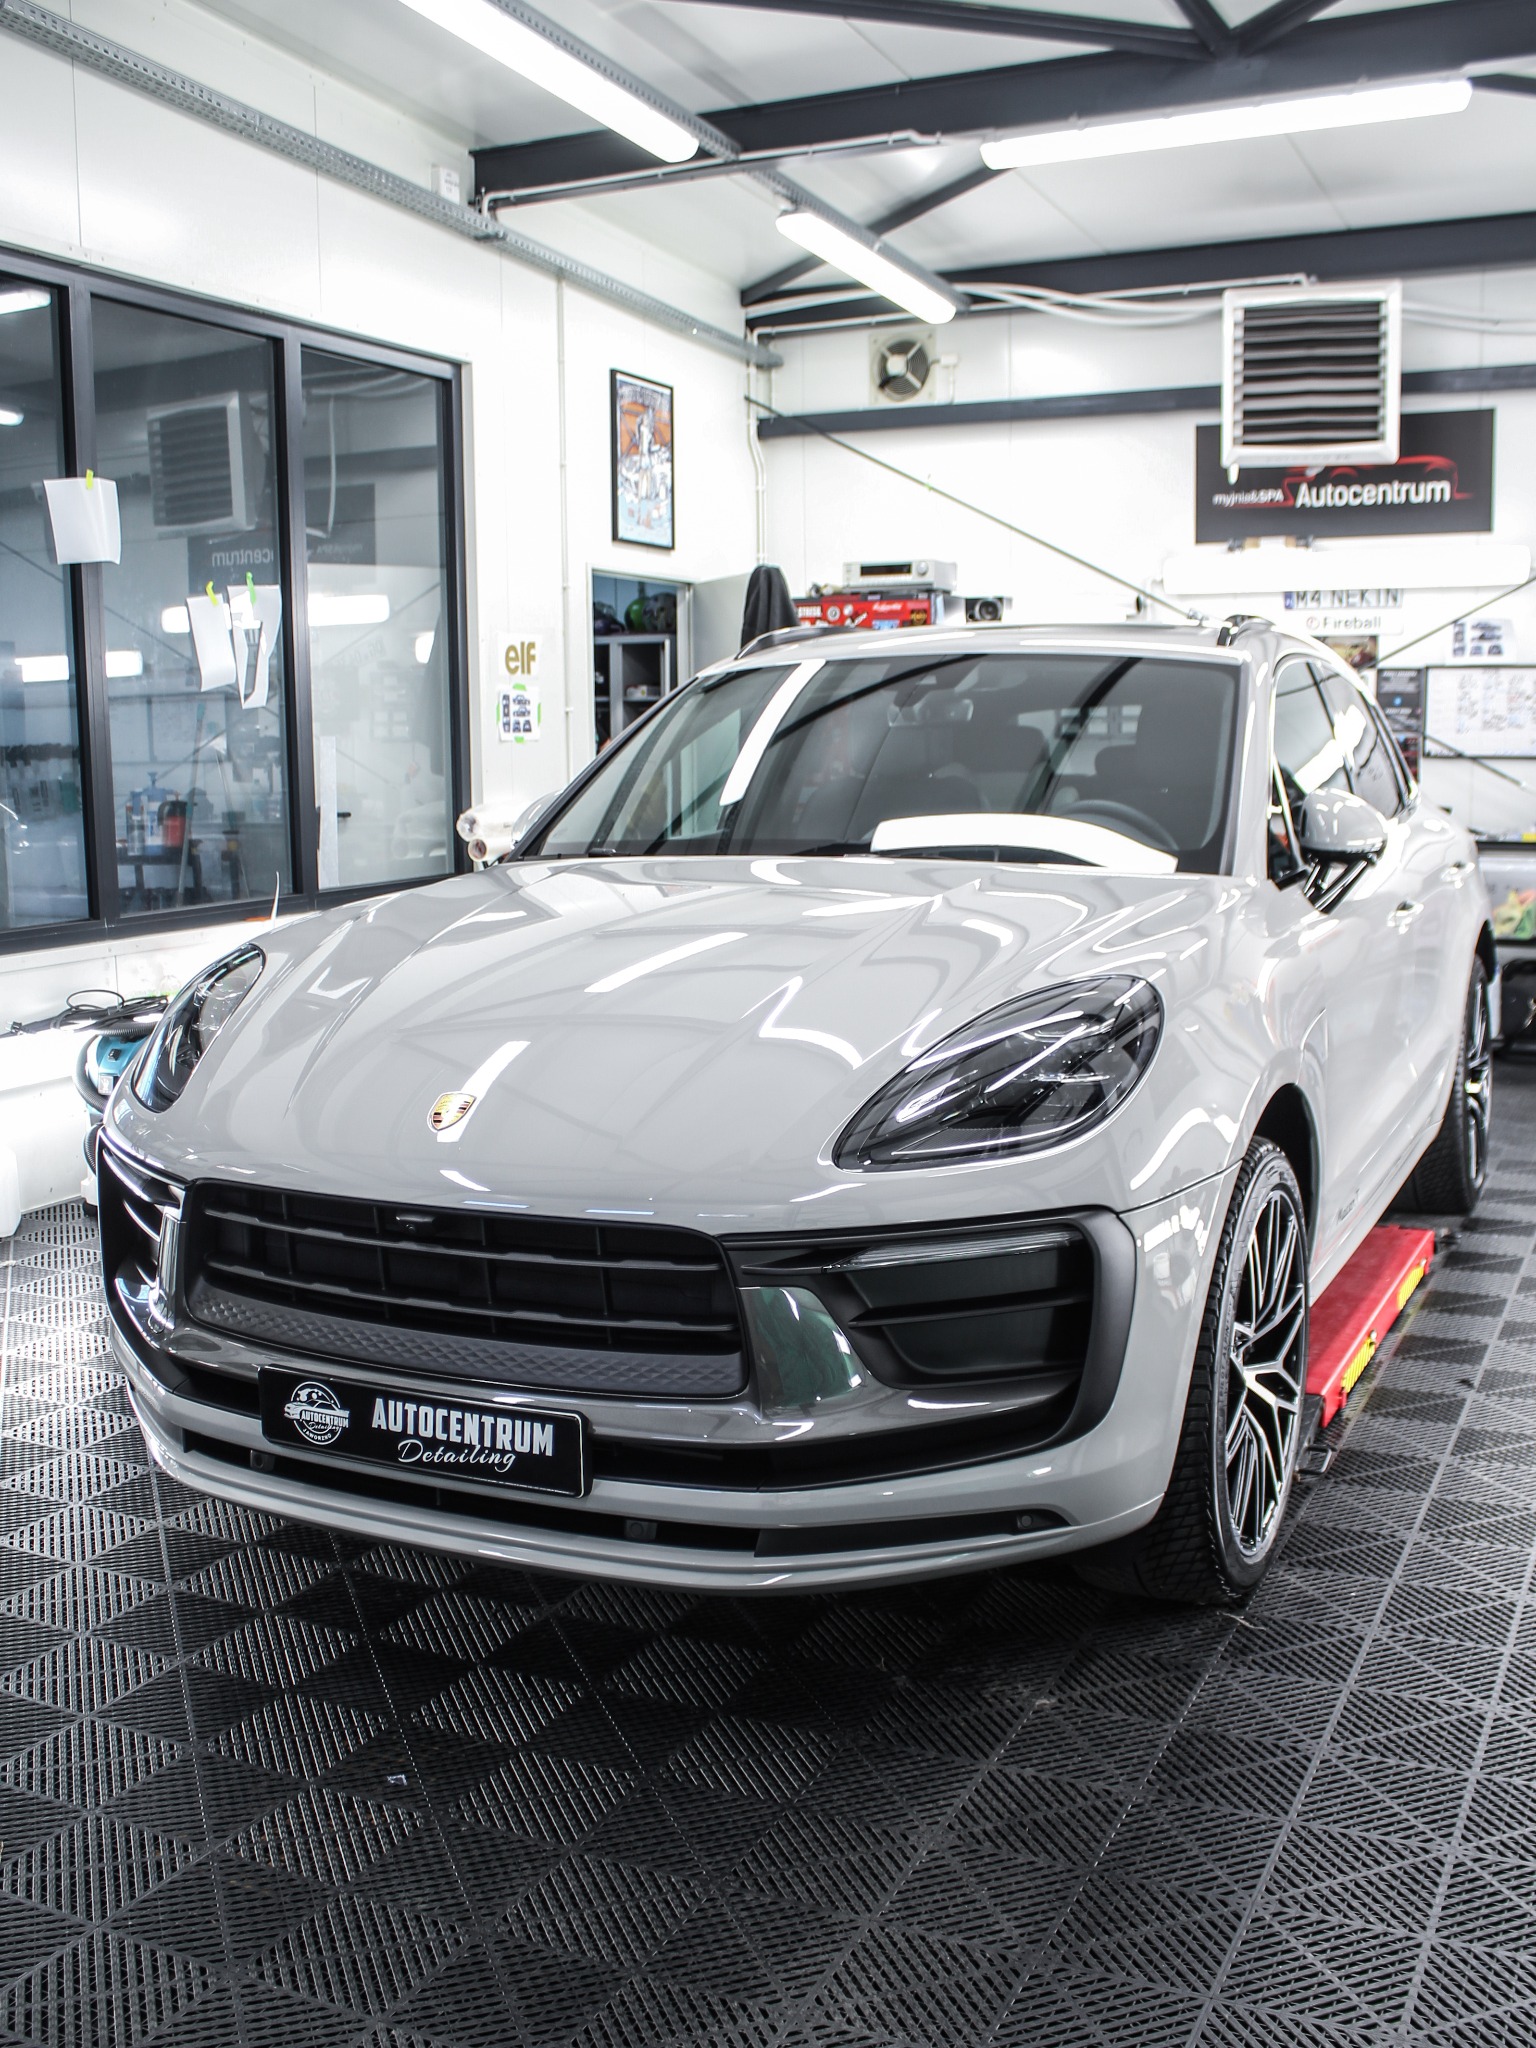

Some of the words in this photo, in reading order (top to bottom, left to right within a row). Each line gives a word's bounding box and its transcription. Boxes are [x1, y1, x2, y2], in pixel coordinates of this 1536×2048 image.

[1295, 480, 1451, 508] Autocentrum
[1323, 616, 1381, 630] Fireball
[505, 641, 536, 676] elf
[301, 1410, 349, 1428] AUTOCENTRUM
[372, 1398, 554, 1456] AUTOCENTRUM
[398, 1439, 517, 1473] Detailing
